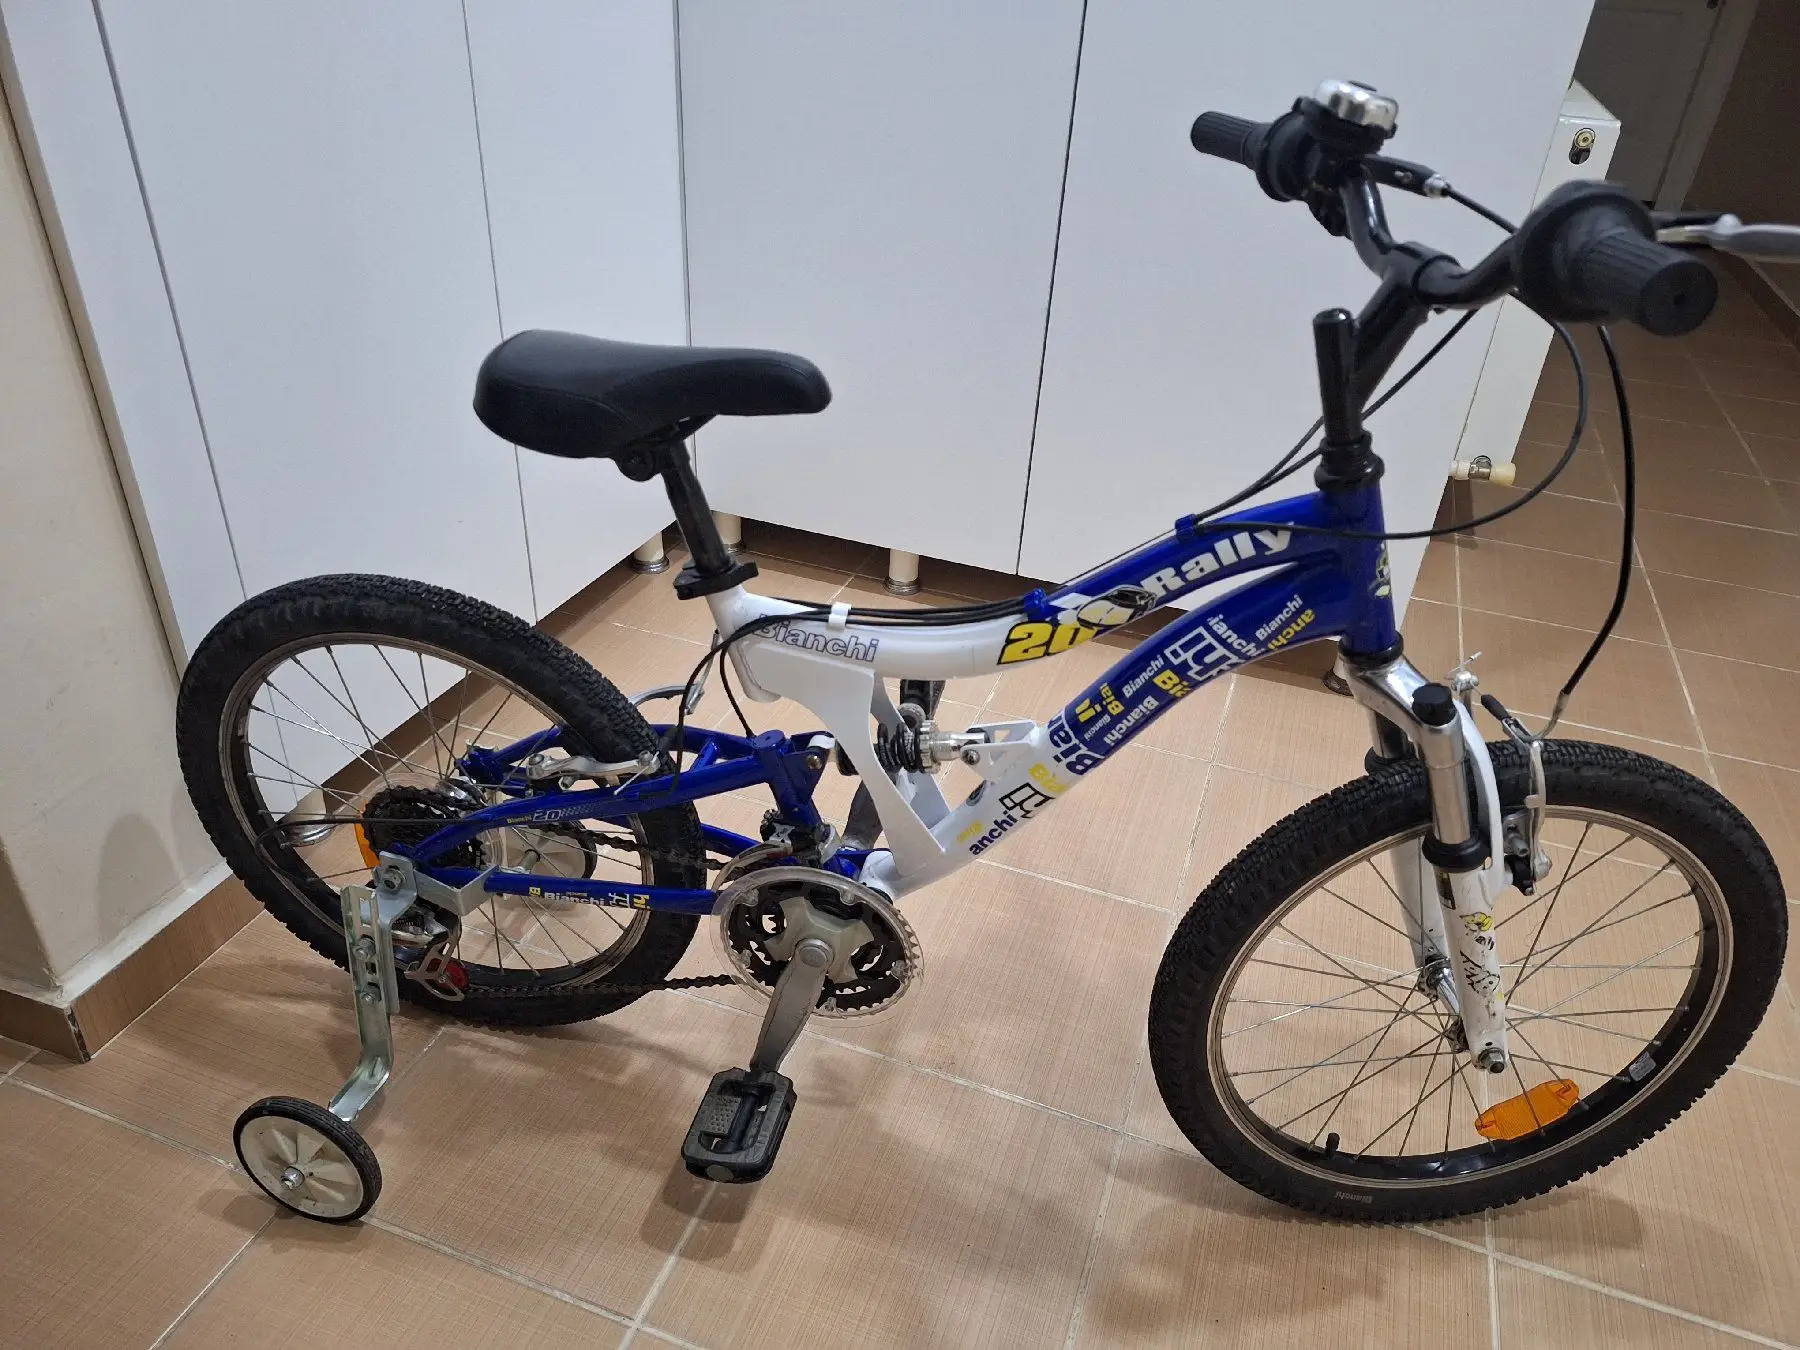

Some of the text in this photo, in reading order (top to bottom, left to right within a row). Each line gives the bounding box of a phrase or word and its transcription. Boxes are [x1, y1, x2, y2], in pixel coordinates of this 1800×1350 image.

[1140, 521, 1295, 597] Rally
[1256, 594, 1303, 641] Bianchi
[1122, 654, 1165, 698] Bianchi
[1103, 695, 1159, 746] Bianchi
[969, 810, 1019, 856] anchi
